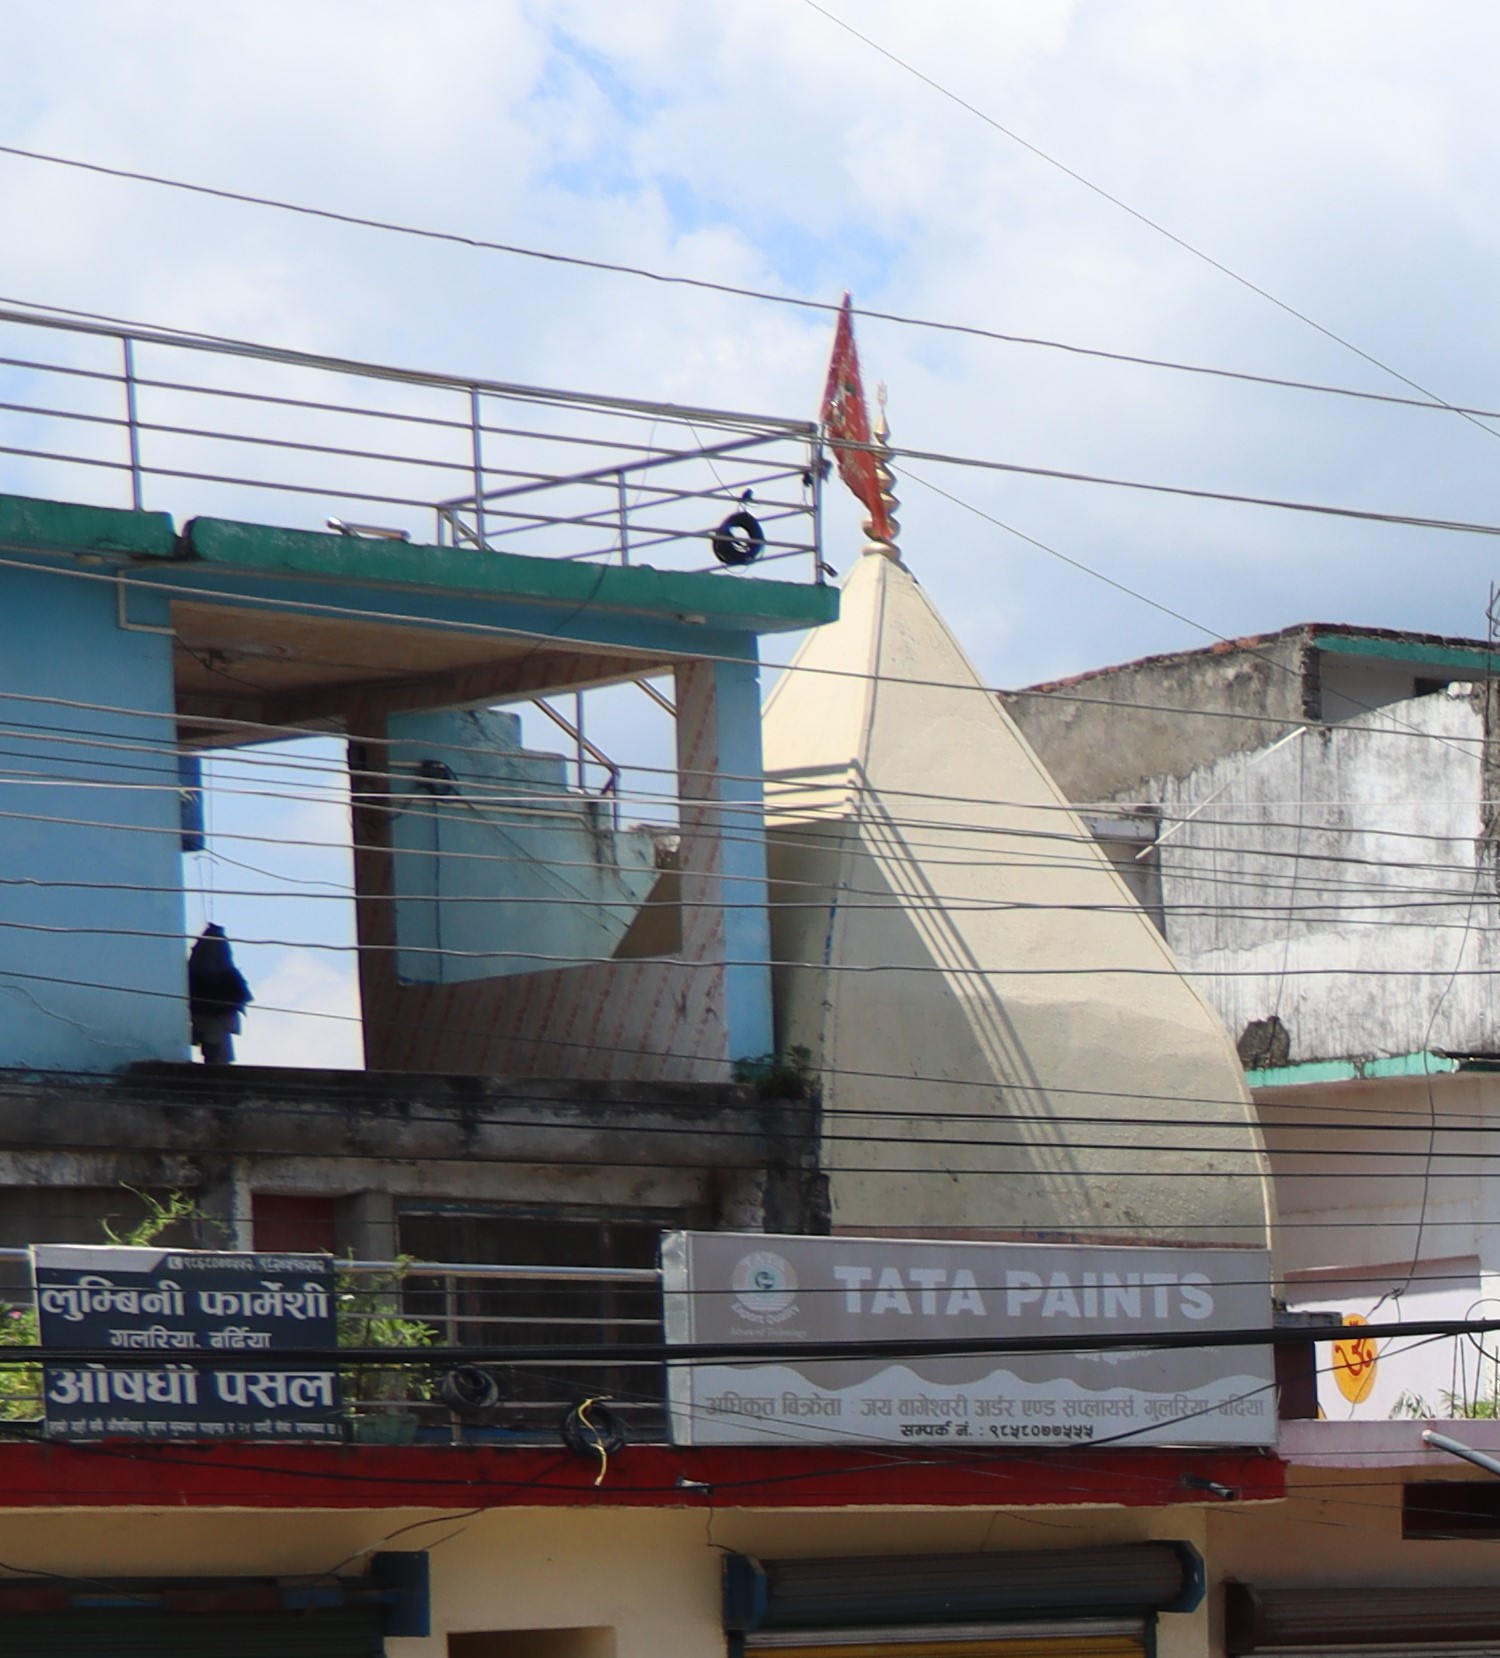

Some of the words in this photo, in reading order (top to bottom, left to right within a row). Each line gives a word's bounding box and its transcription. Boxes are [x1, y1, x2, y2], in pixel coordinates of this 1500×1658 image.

[39, 1275, 186, 1322] लुम्बिनी
[198, 1280, 330, 1320] फार्मेशी
[834, 1266, 987, 1317] TATA
[1006, 1270, 1215, 1320] PAINTS
[214, 1371, 336, 1408] पसल
[860, 1399, 893, 1417] जय
